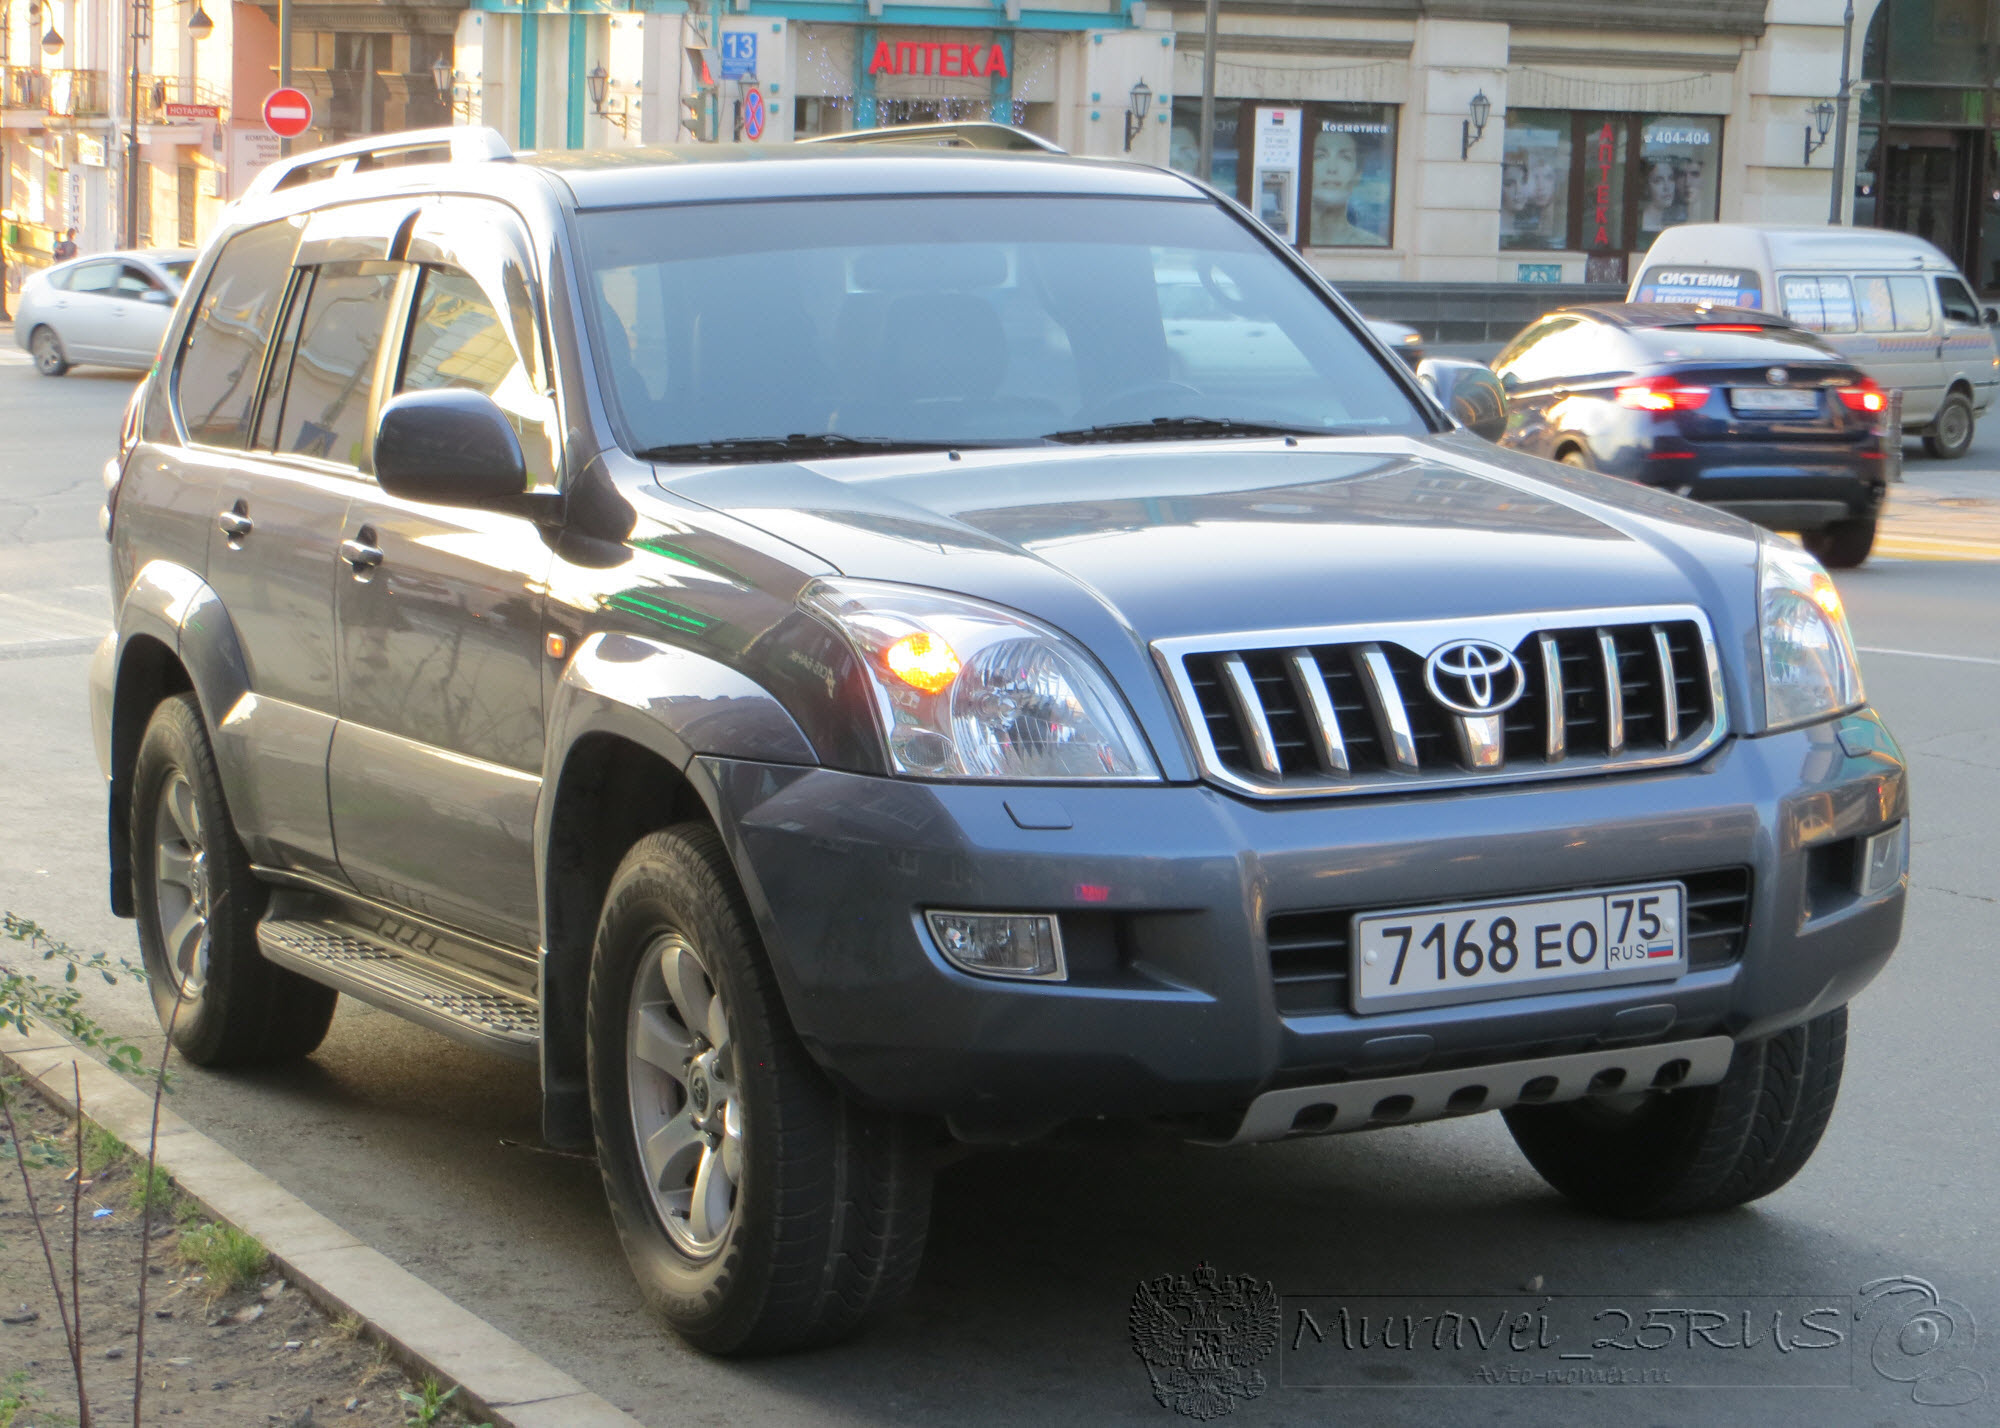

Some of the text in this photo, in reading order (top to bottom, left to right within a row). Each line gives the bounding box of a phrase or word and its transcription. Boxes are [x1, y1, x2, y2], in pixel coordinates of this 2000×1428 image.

[726, 34, 754, 59] 13
[868, 41, 1009, 78] АПТЕКА
[169, 105, 216, 117] НОТАРИУС
[1321, 120, 1389, 134] Косметика
[1655, 131, 1711, 145] 404-404
[1594, 123, 1614, 244] АПТЕКА
[1658, 272, 1740, 288] СИСТЕМЫ
[1611, 896, 1661, 944] 75
[1382, 915, 1519, 985] 7168
[1610, 943, 1646, 962] RUS
